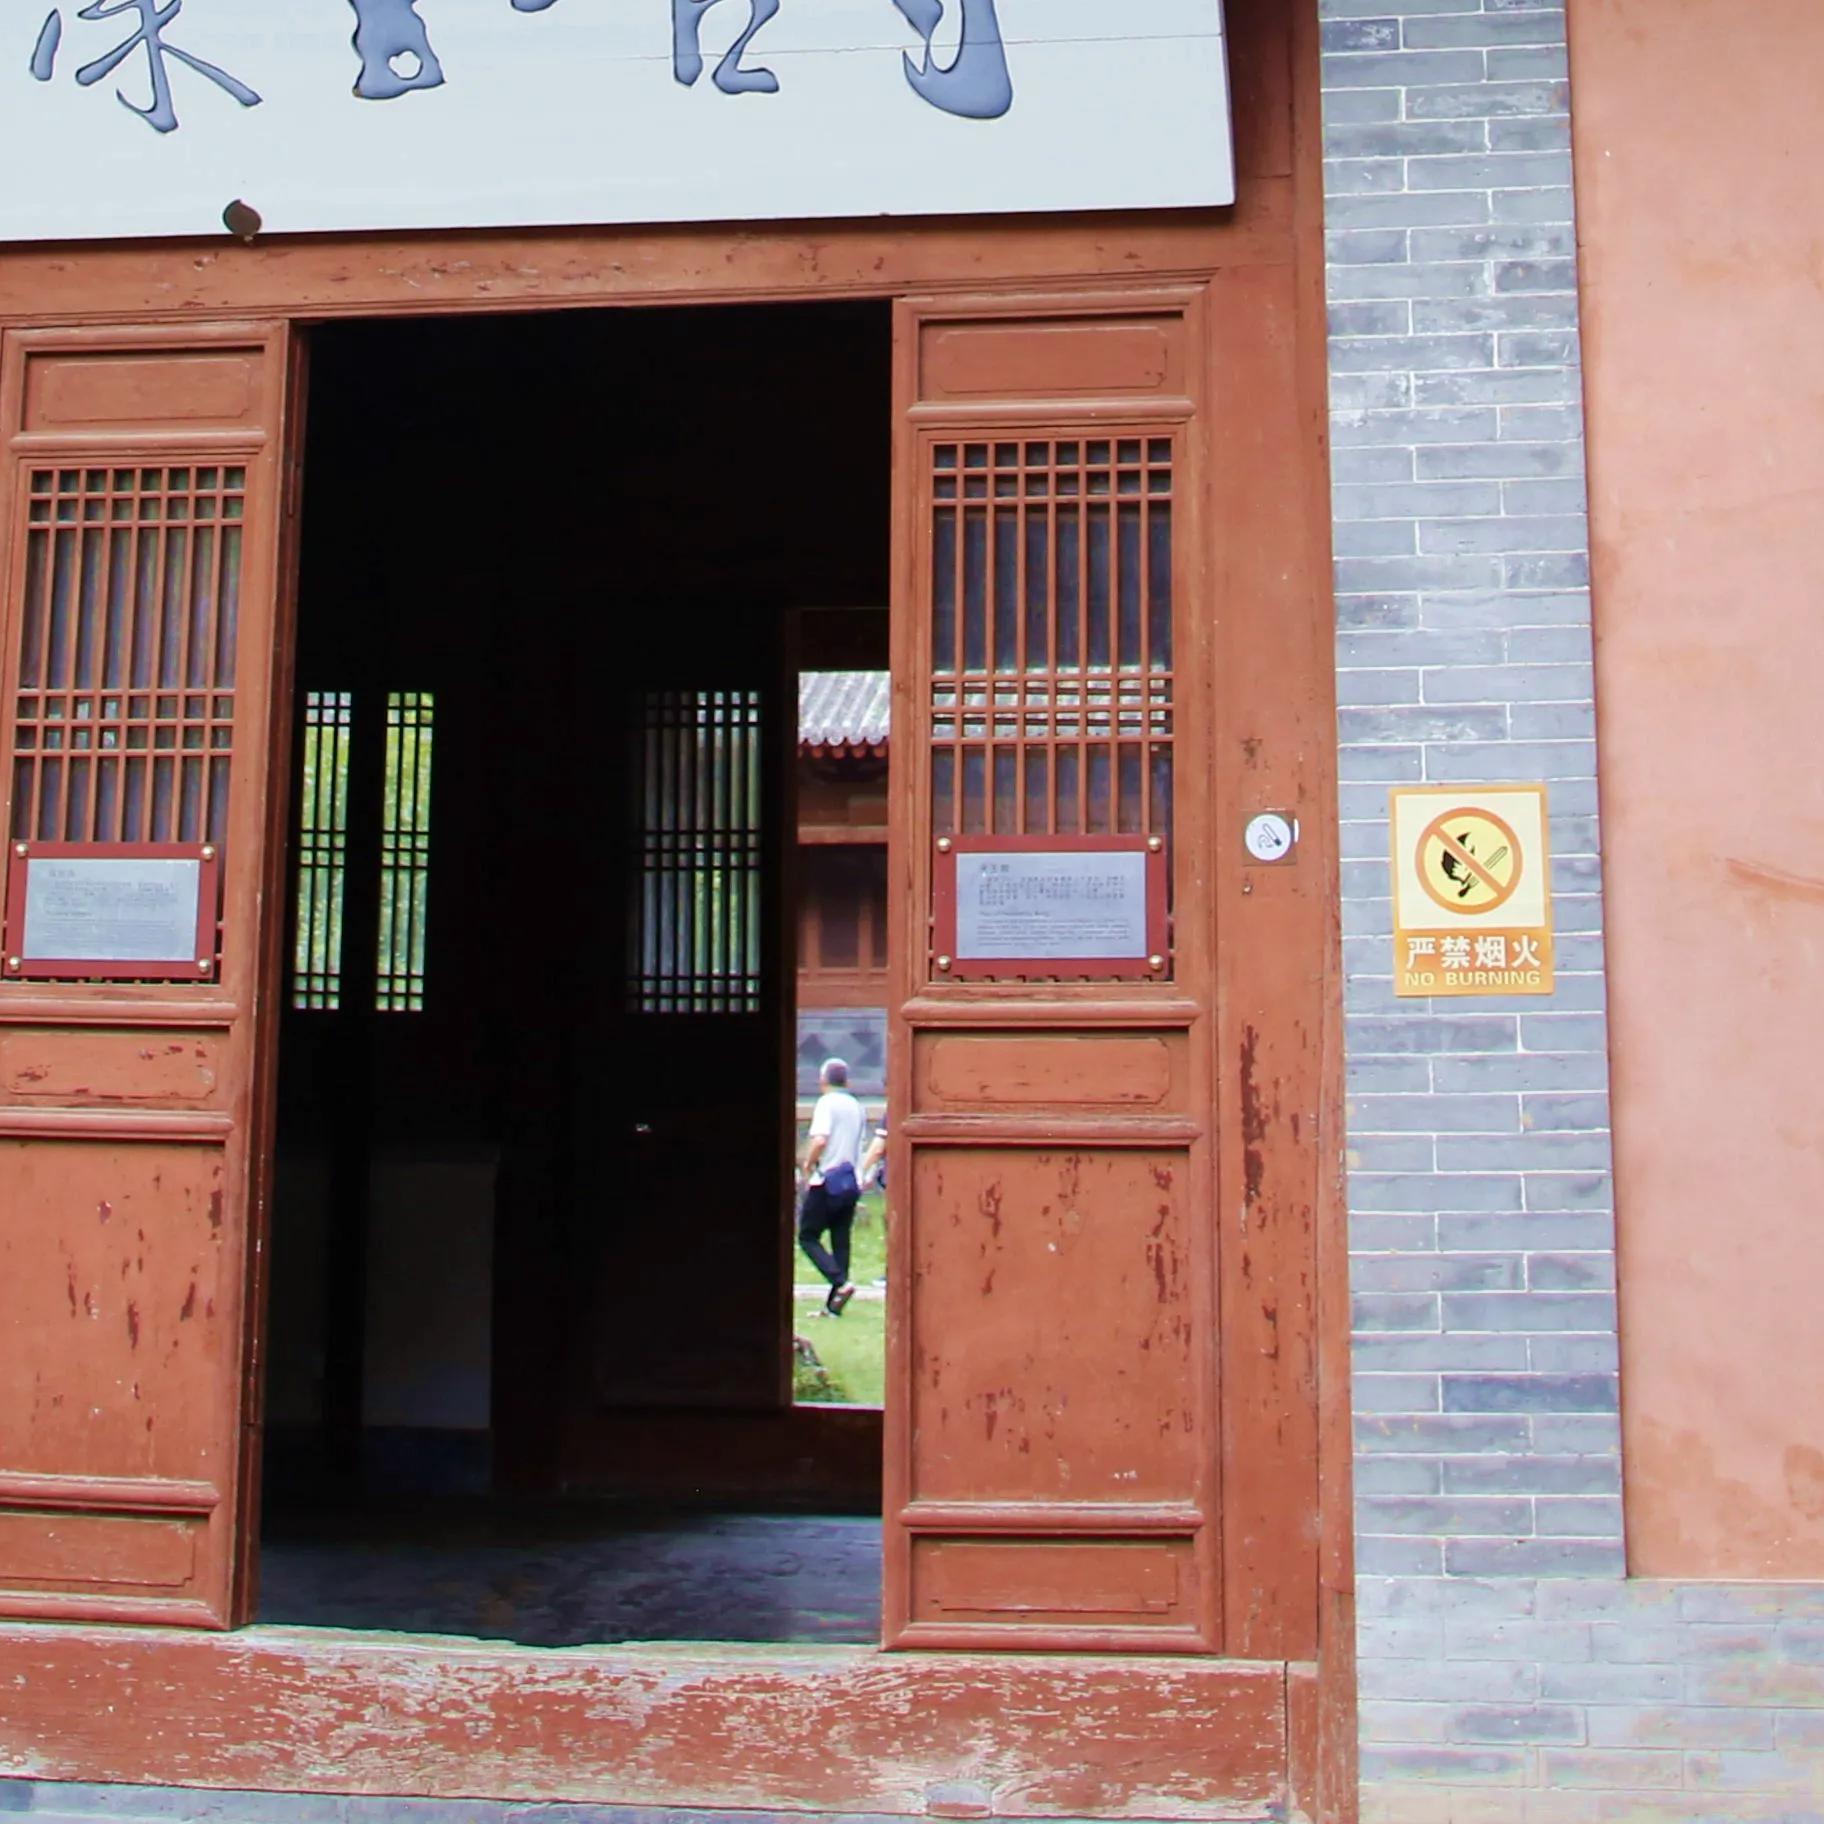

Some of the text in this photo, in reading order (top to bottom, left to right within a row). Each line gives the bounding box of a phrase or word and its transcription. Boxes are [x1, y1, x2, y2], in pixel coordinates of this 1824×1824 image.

[1406, 936, 1542, 970] 严禁烟火
[1404, 970, 1541, 987] NO BURNING
